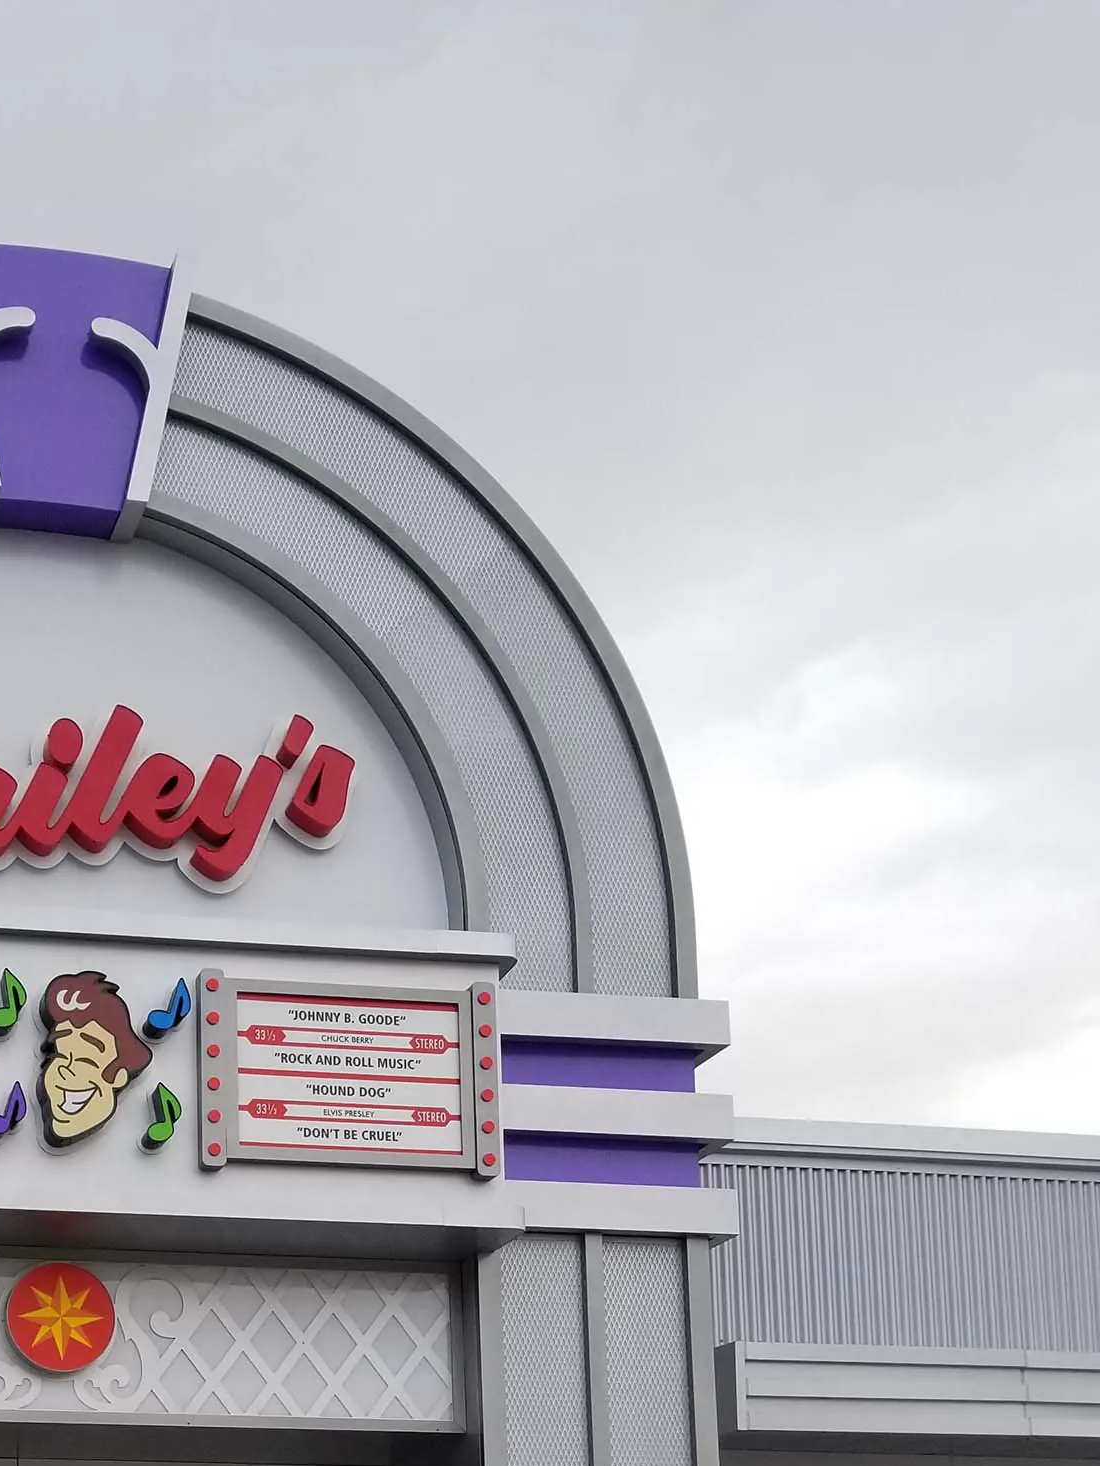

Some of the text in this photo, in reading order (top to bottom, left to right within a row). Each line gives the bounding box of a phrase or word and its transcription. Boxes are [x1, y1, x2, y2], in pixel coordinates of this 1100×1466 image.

[288, 1009, 406, 1026] "JOHNNY B. GOODE"
[321, 1035, 349, 1043] CHUCK
[416, 1037, 445, 1049] STEREO
[274, 1052, 421, 1070] "ROCK AND ROLL MUSIC"
[306, 1083, 391, 1099] "HOUND DOG"
[418, 1111, 446, 1122] STEREO
[296, 1127, 403, 1142] "DON'T BE CRUEL"
